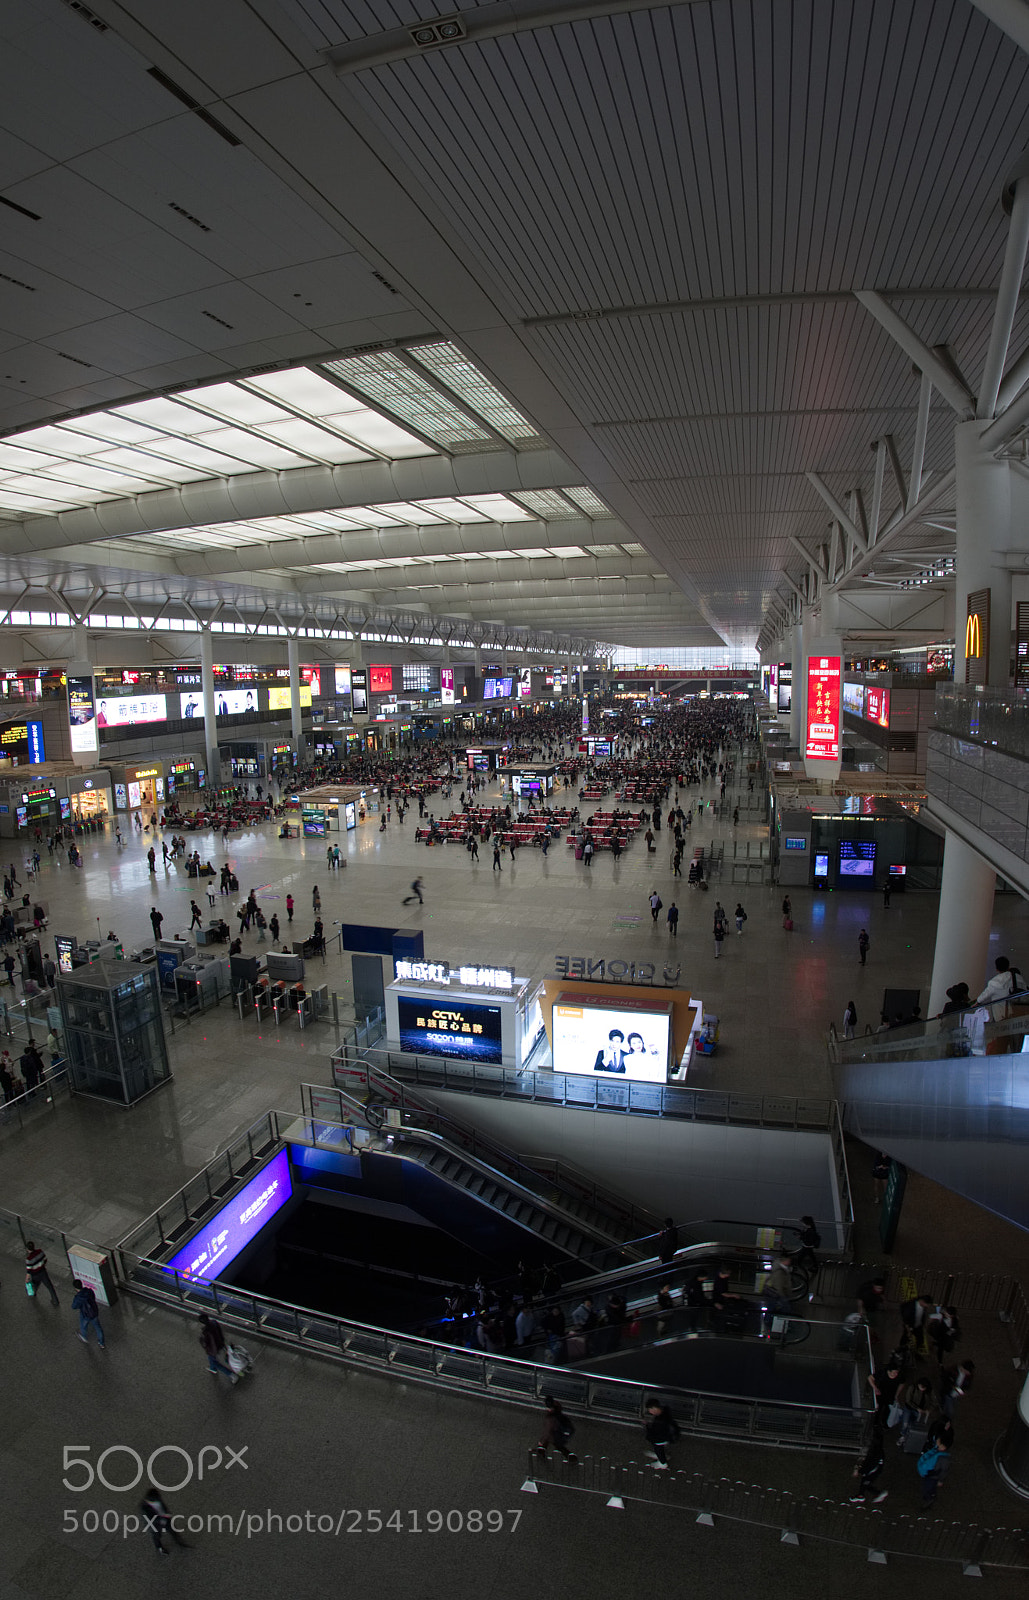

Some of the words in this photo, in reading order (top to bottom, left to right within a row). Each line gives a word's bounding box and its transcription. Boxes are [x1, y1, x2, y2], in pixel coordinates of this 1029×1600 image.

[815, 682, 823, 715] 新年快乐
[416, 1017, 484, 1035] 民族匠心品牌
